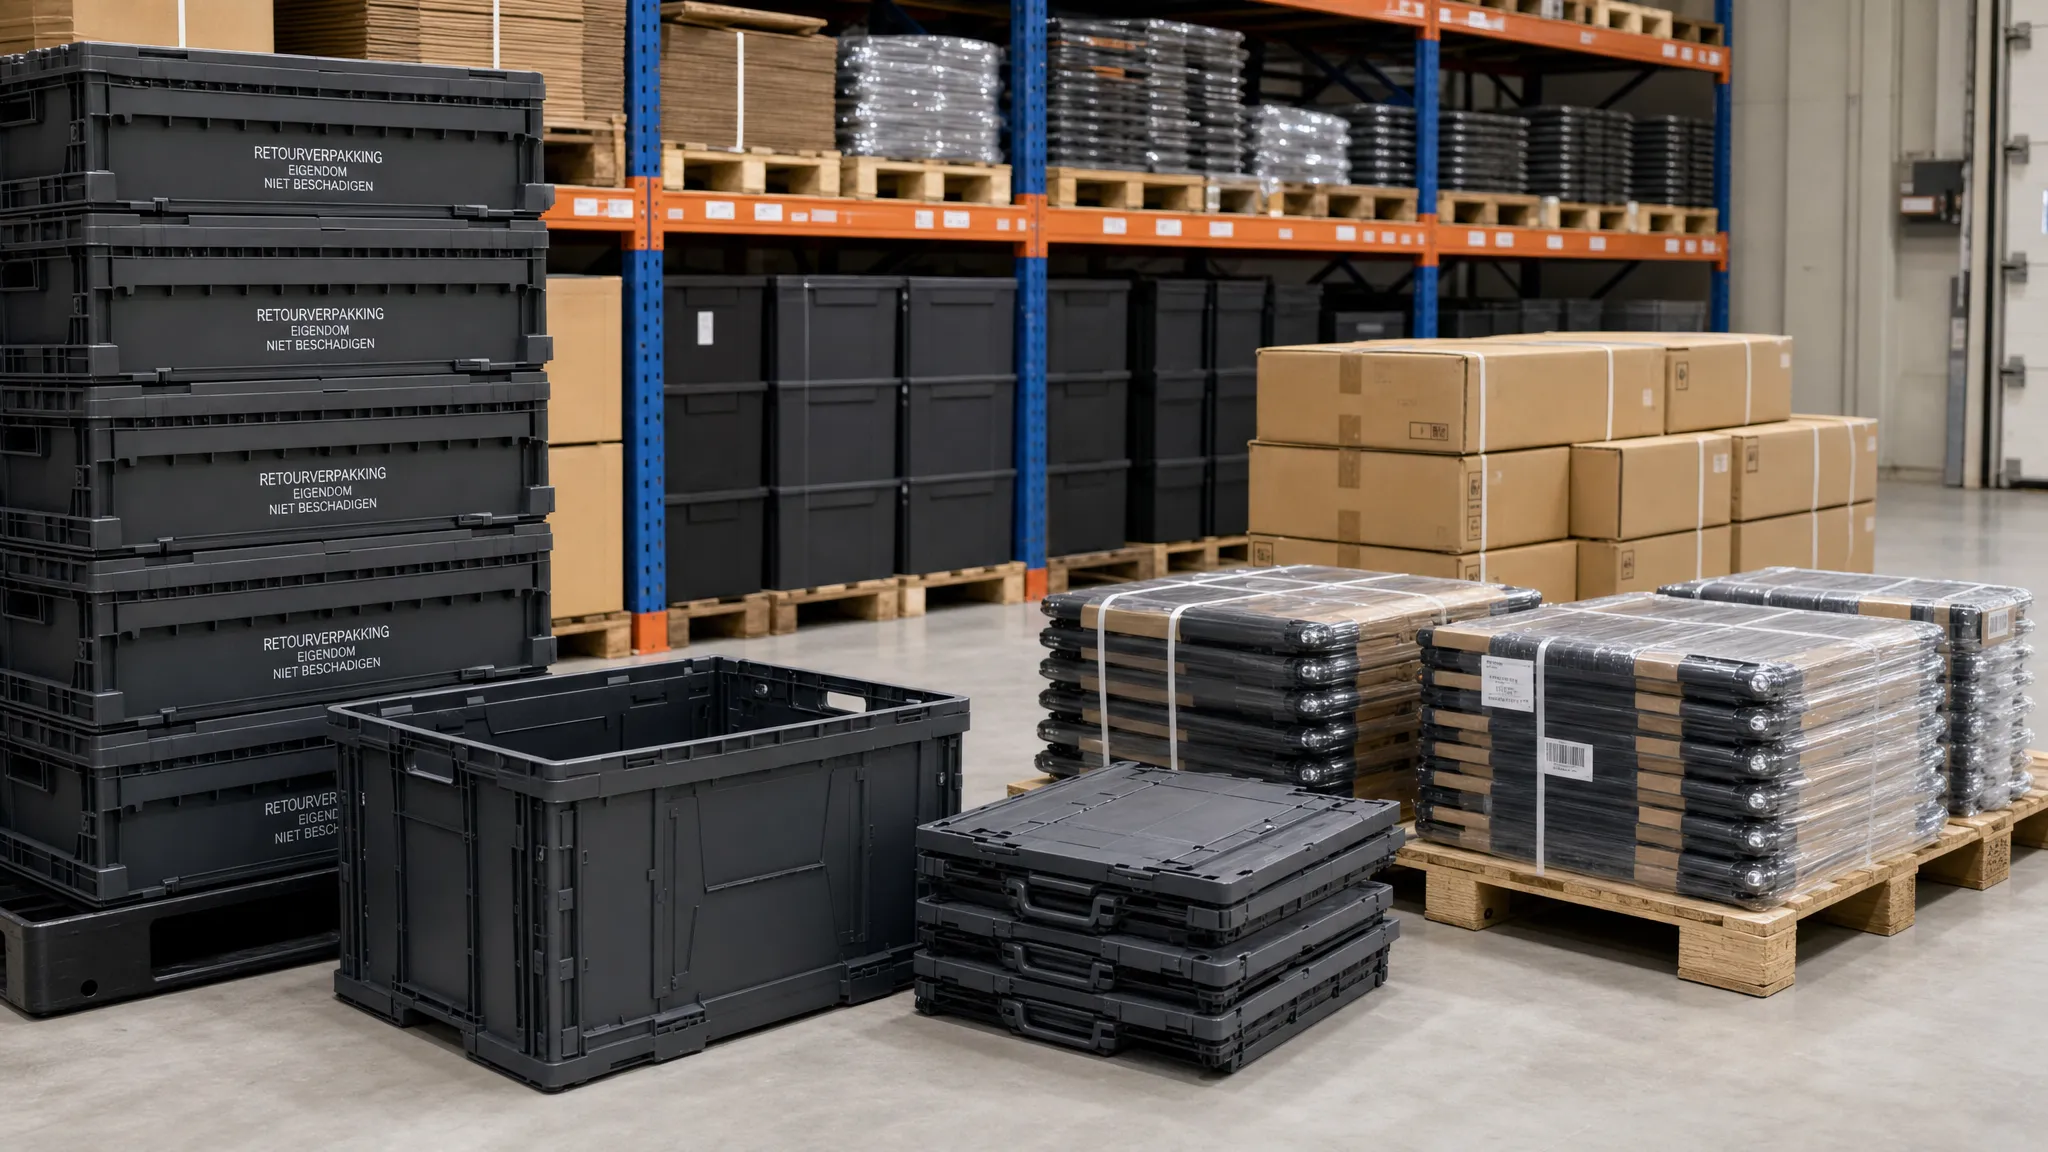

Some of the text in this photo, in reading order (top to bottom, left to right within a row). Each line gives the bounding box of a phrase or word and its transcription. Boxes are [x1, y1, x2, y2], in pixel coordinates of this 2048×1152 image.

[254, 145, 383, 164] RETOURVERPAKKING
[288, 164, 347, 177] EIGENDOM
[264, 177, 374, 192] NIET BESCHADIGEN
[257, 307, 384, 322] RETOURVERPAKKING
[291, 325, 350, 336] EIGENDOM
[266, 338, 375, 351] NIET BESCHADIGEN
[259, 466, 387, 486] RETOURVERPAKKING
[293, 485, 352, 500] EIGENDOM
[269, 497, 377, 515] NIET BESCHADIGEN
[263, 625, 390, 651] RETOURVERPAKKING
[297, 646, 356, 662] EIGENDOM
[273, 657, 381, 680] NIET BESCHADIGEN
[265, 791, 338, 816] RETOURVER
[298, 808, 338, 825] EIGEND
[275, 822, 338, 844] NIET BESCH
